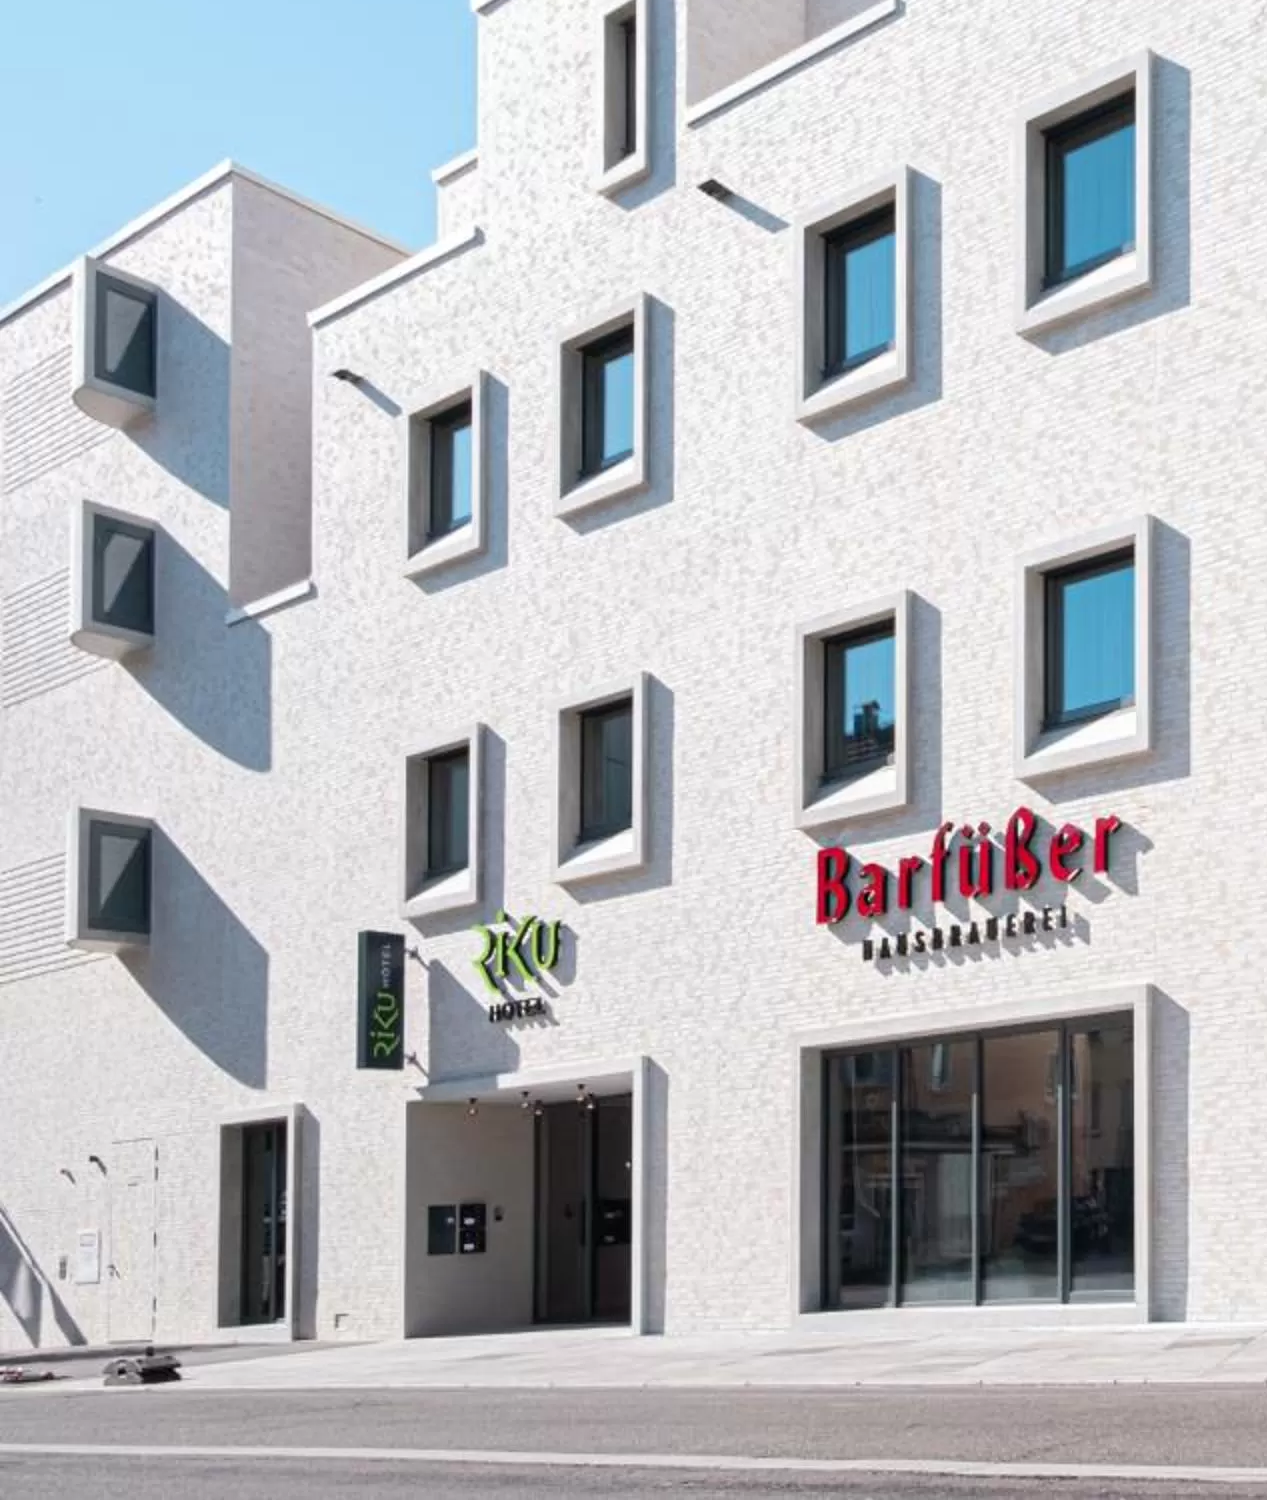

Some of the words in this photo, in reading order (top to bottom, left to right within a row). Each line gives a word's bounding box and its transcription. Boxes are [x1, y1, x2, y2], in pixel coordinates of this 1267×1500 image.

[815, 805, 1122, 924] Barfüßer
[862, 903, 1067, 961] HAUSBRAUEREI
[381, 943, 391, 989] HOTEL
[489, 997, 547, 1023] HOTEL
